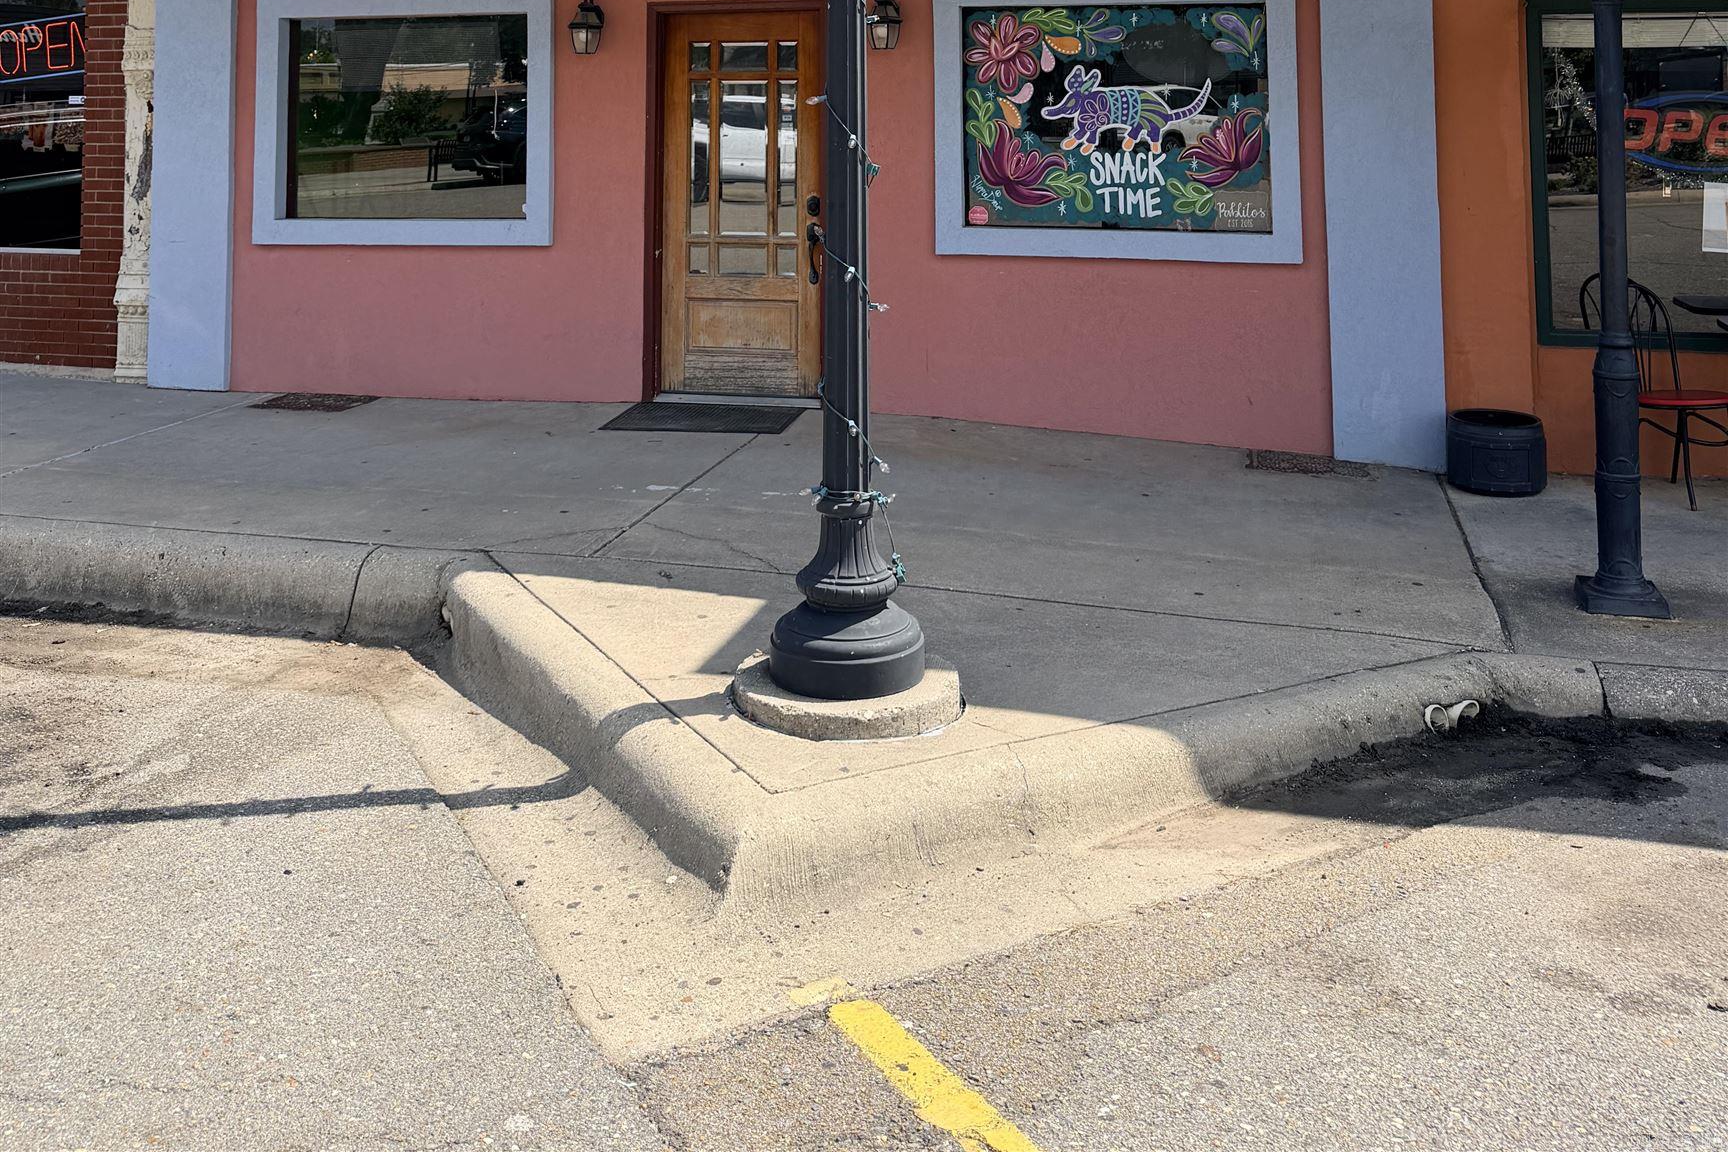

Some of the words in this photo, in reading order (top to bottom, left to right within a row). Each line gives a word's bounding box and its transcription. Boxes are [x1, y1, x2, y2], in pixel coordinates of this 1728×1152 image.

[0, 21, 86, 75] OPEN
[1089, 151, 1167, 186] SNACK
[1095, 187, 1162, 218] TIME
